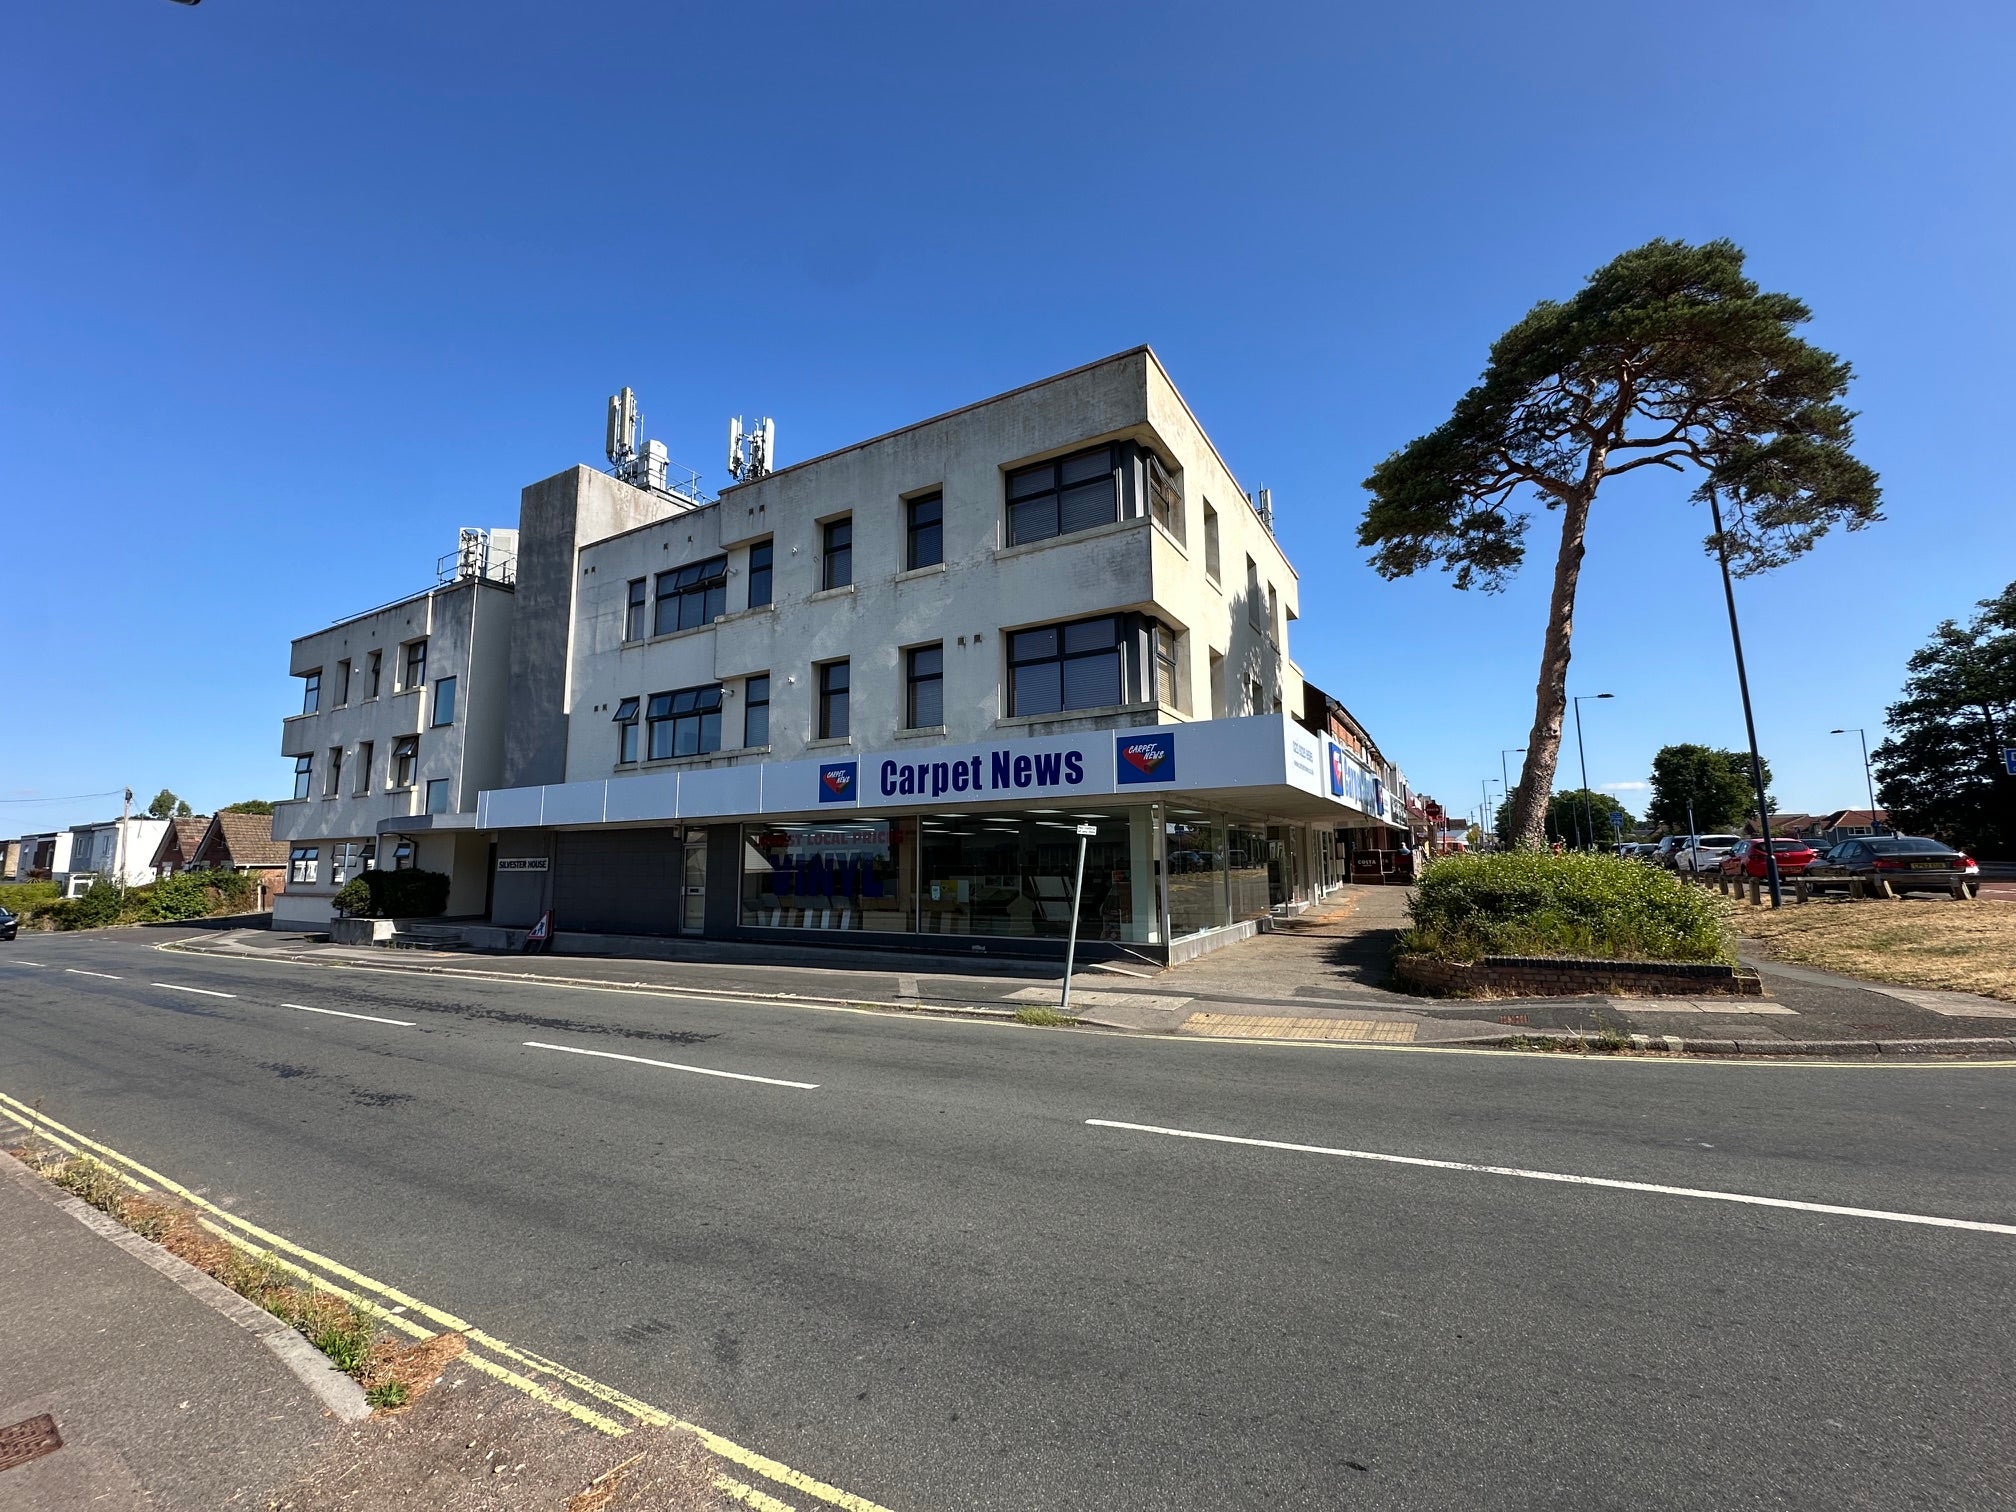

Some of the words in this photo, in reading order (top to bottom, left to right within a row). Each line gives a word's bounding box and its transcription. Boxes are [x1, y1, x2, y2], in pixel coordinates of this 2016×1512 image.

[1128, 743, 1158, 754] CARPET
[1143, 749, 1164, 760] NEWS
[826, 770, 847, 779] CARPET
[881, 757, 982, 797] Carpet
[992, 750, 1083, 789] News
[835, 776, 850, 784] NEWS
[807, 833, 848, 846] LOCAL
[854, 831, 903, 845] PRICES
[499, 861, 526, 869] SILVESTER
[527, 860, 547, 869] HOUSE
[770, 852, 883, 897] VINYL
